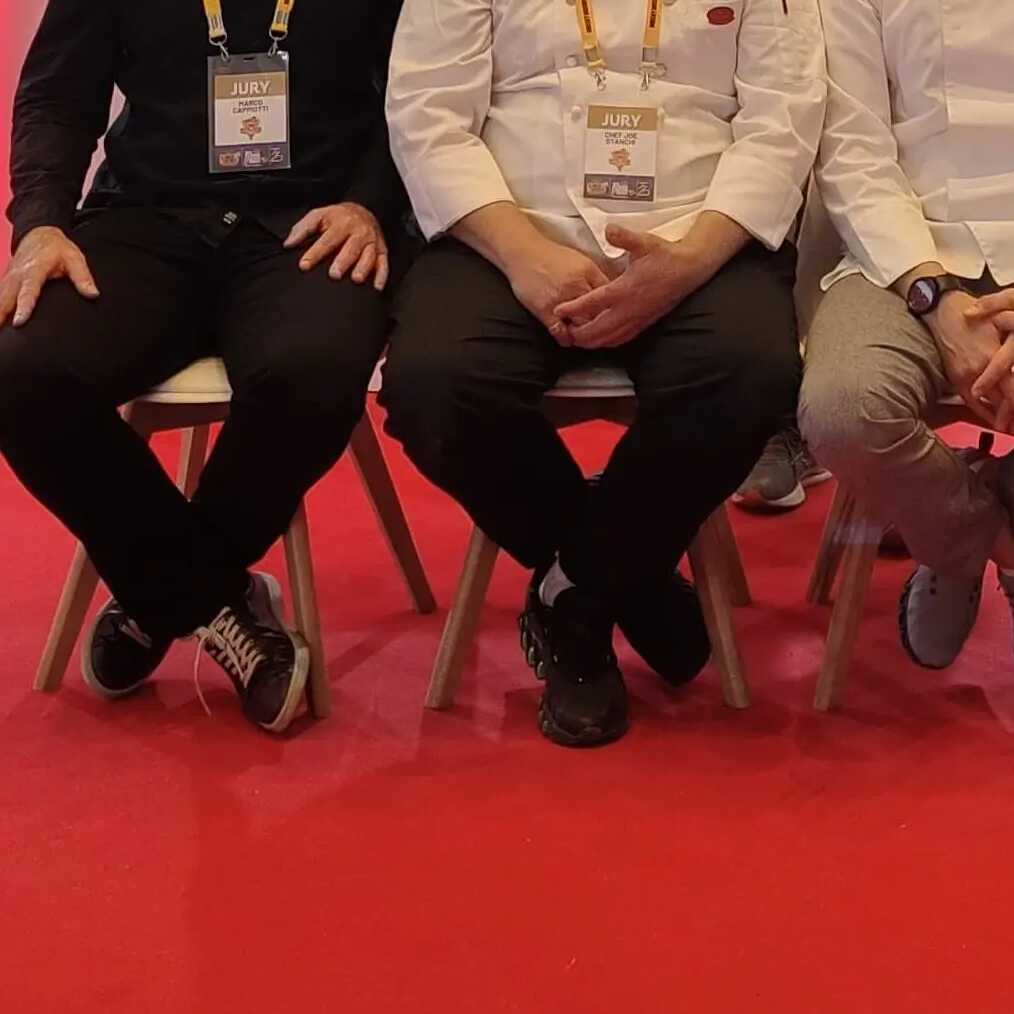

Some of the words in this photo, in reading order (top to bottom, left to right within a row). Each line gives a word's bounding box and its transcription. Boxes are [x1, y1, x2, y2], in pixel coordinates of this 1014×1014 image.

[230, 80, 271, 96] JURY
[238, 99, 263, 107] MARCO
[601, 113, 642, 127] JURY
